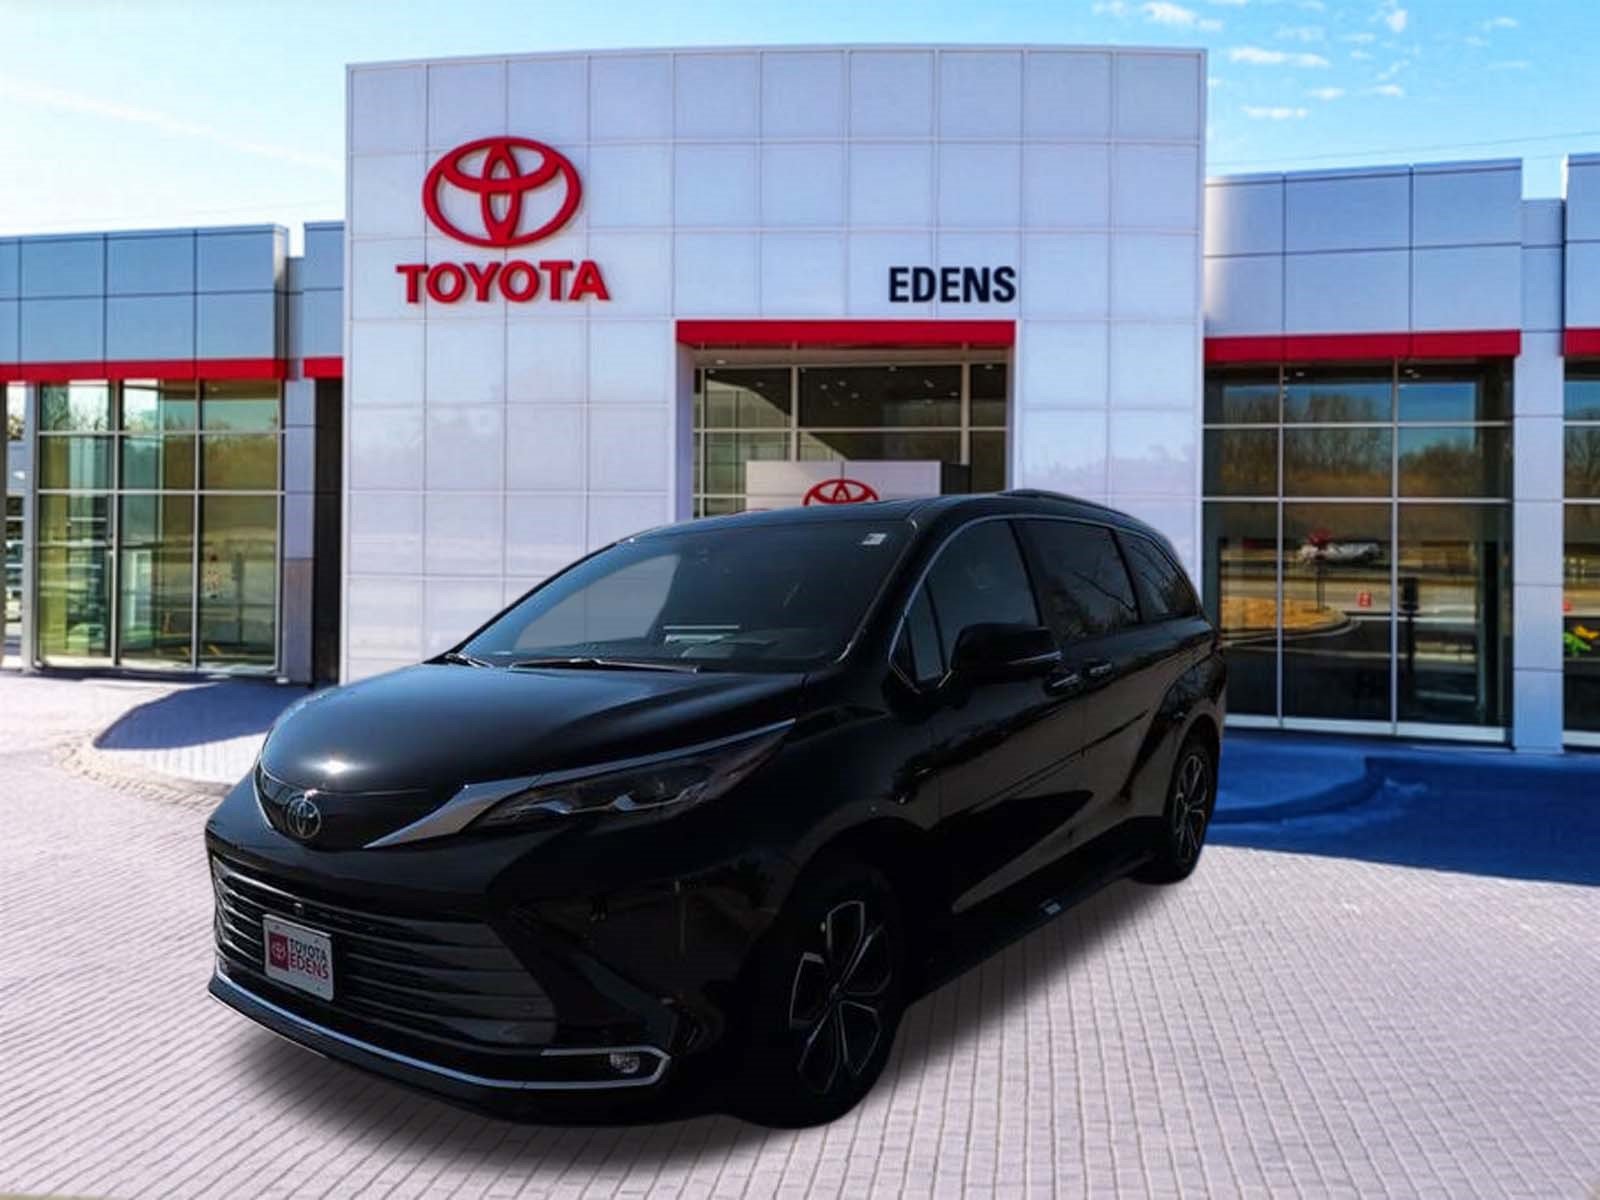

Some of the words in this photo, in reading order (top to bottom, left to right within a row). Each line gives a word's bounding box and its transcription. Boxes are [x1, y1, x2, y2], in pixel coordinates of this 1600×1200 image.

[396, 260, 611, 304] TOYOTA
[889, 266, 1017, 303] EDENS
[289, 938, 328, 962] TOYOTA
[290, 953, 329, 980] EDENS
